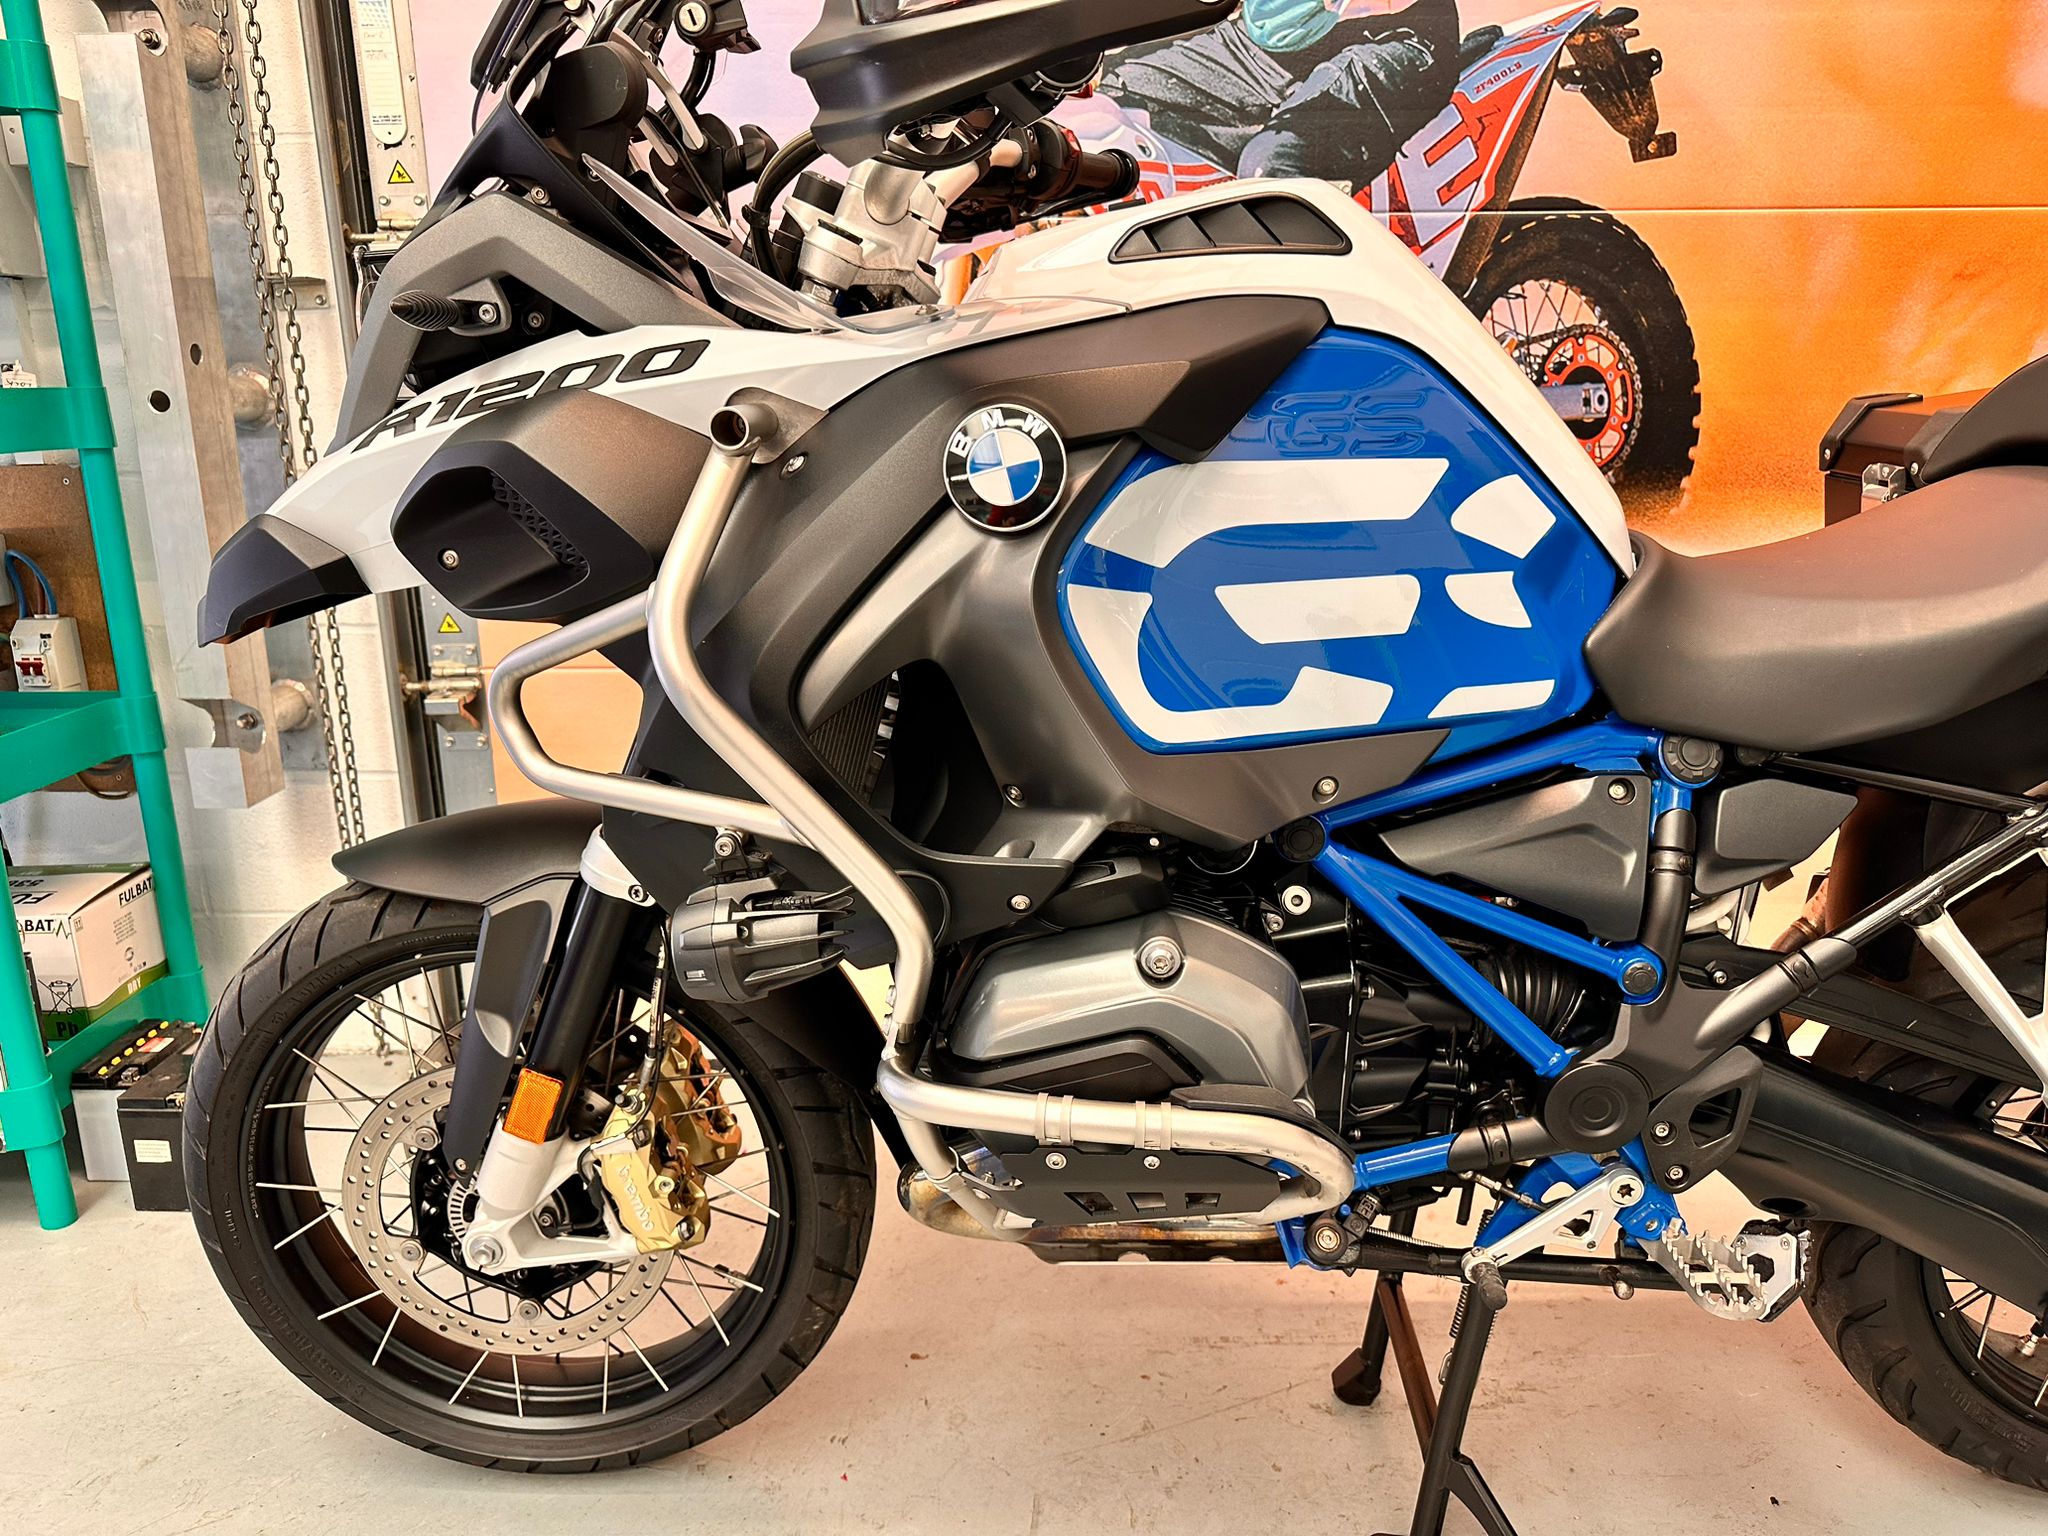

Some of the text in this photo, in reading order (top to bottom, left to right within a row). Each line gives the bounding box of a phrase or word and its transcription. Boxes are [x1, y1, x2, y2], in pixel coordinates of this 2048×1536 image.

[350, 338, 711, 454] R1200
[949, 408, 1049, 458] BMW
[1271, 390, 1428, 458] GS
[118, 875, 153, 906] FULBAT
[55, 1021, 79, 1038] Pb
